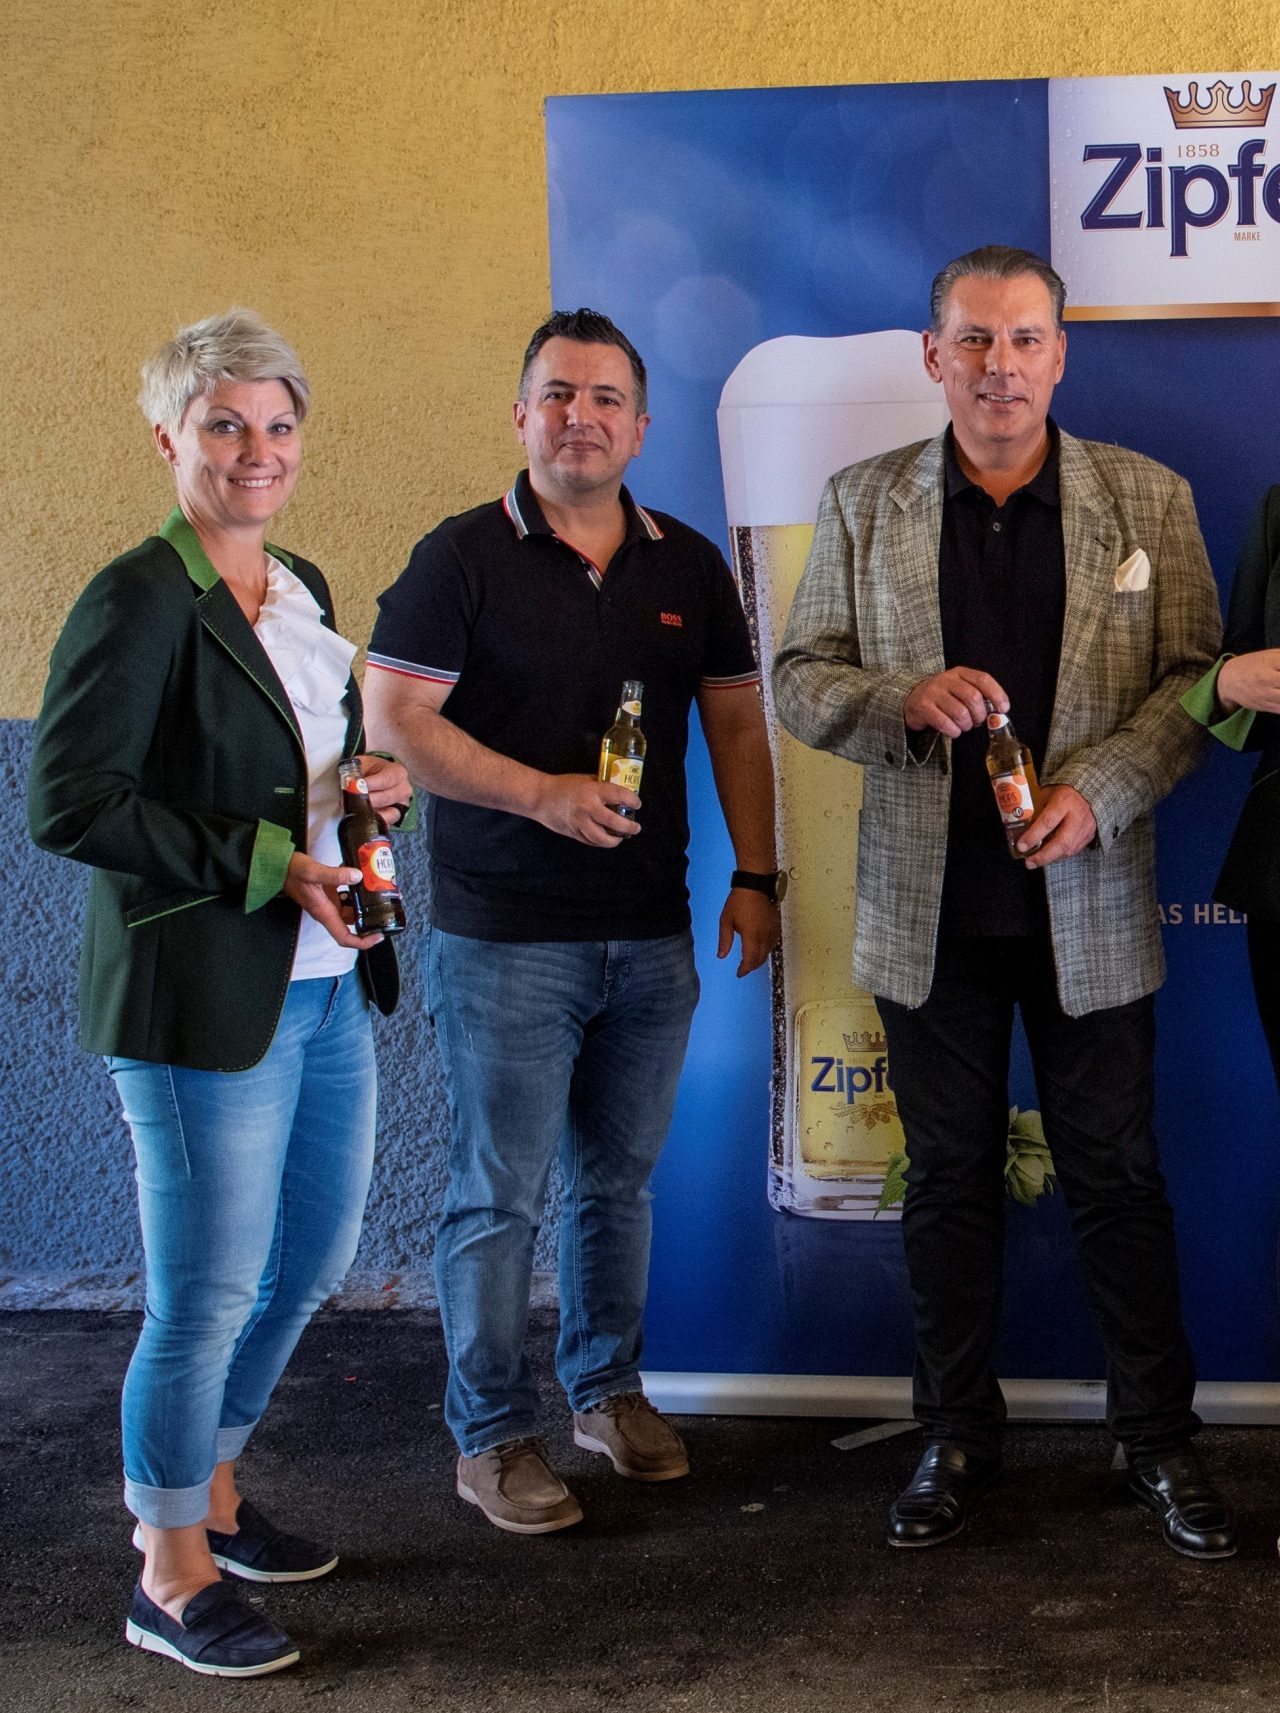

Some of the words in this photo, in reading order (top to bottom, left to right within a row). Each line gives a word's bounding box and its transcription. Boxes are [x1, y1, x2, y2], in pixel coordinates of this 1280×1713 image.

[1177, 143, 1220, 158] 1858
[1233, 231, 1262, 242] MARKE
[810, 1056, 889, 1105] Zipf
